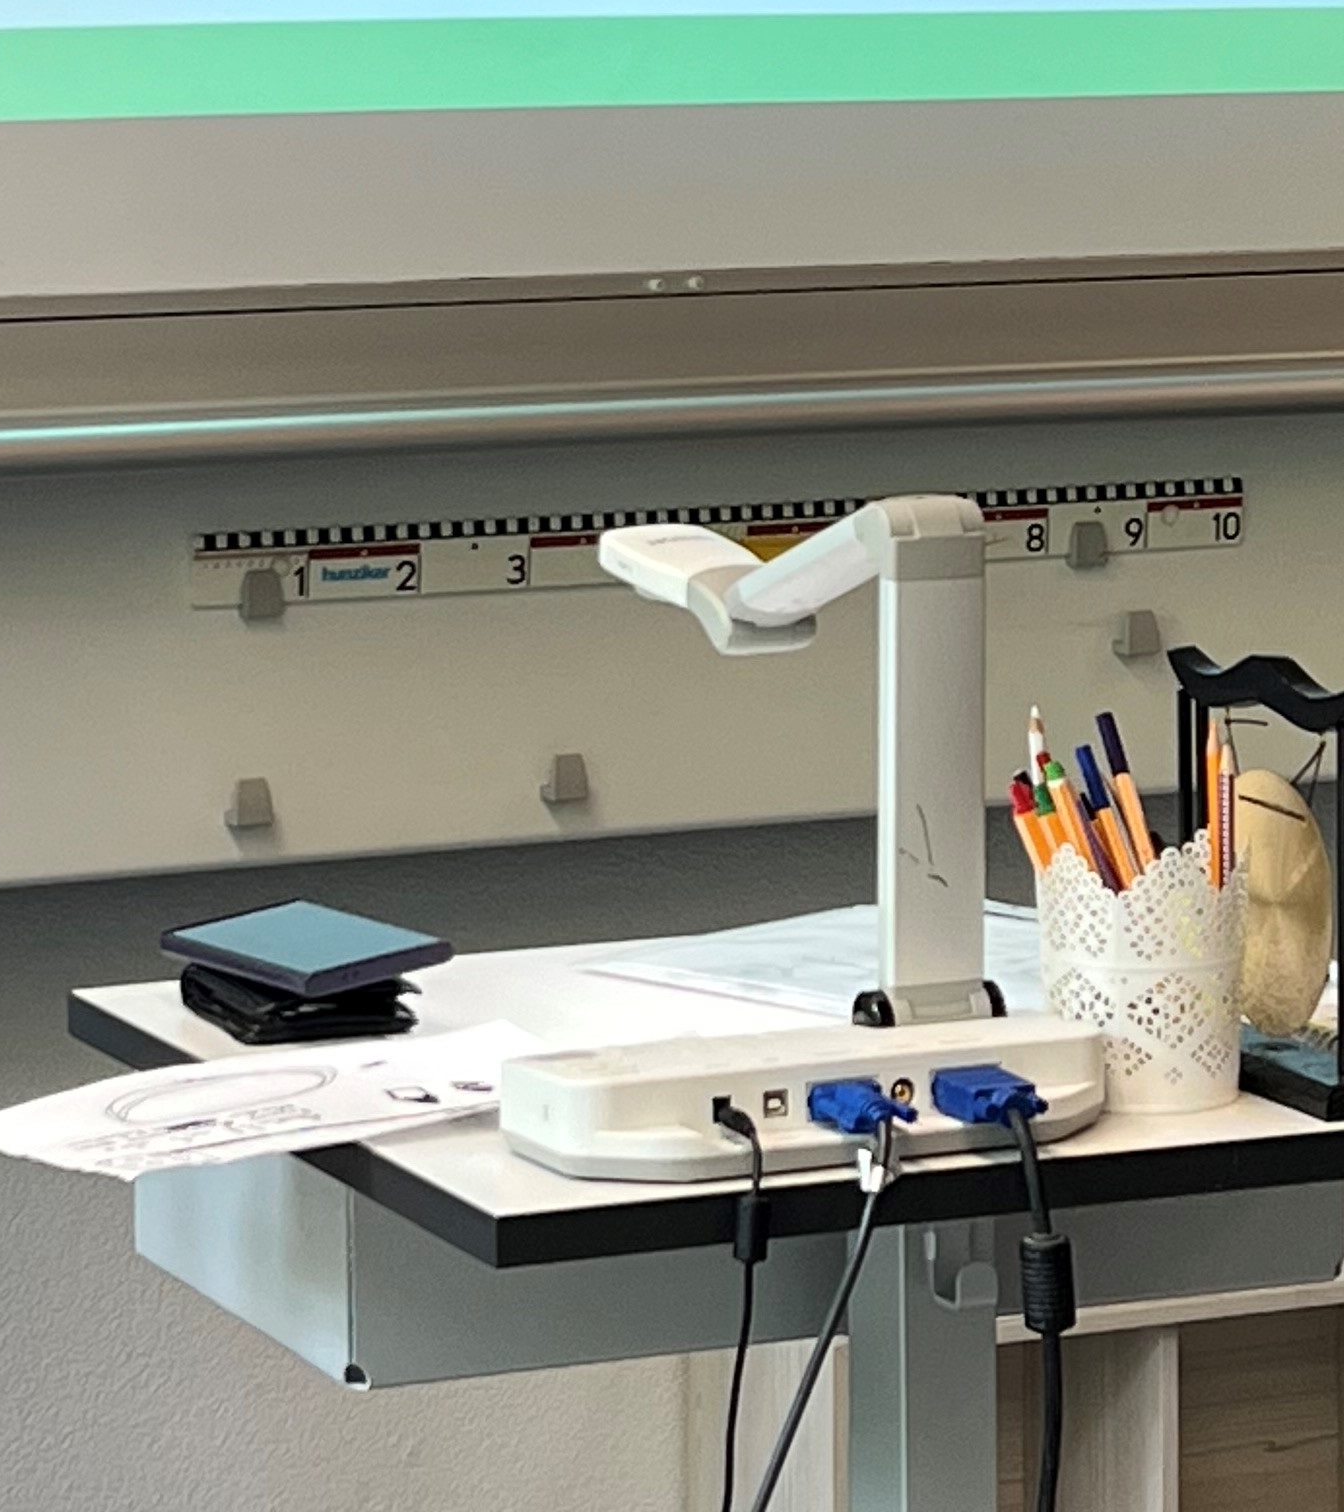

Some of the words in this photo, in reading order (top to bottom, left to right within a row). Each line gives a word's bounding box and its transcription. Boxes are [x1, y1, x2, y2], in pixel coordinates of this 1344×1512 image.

[1025, 523, 1045, 553] 8
[1124, 516, 1144, 547] 9
[1212, 511, 1242, 542] 10
[293, 566, 306, 597] 1
[394, 560, 418, 592] 2
[505, 554, 527, 586] 3
